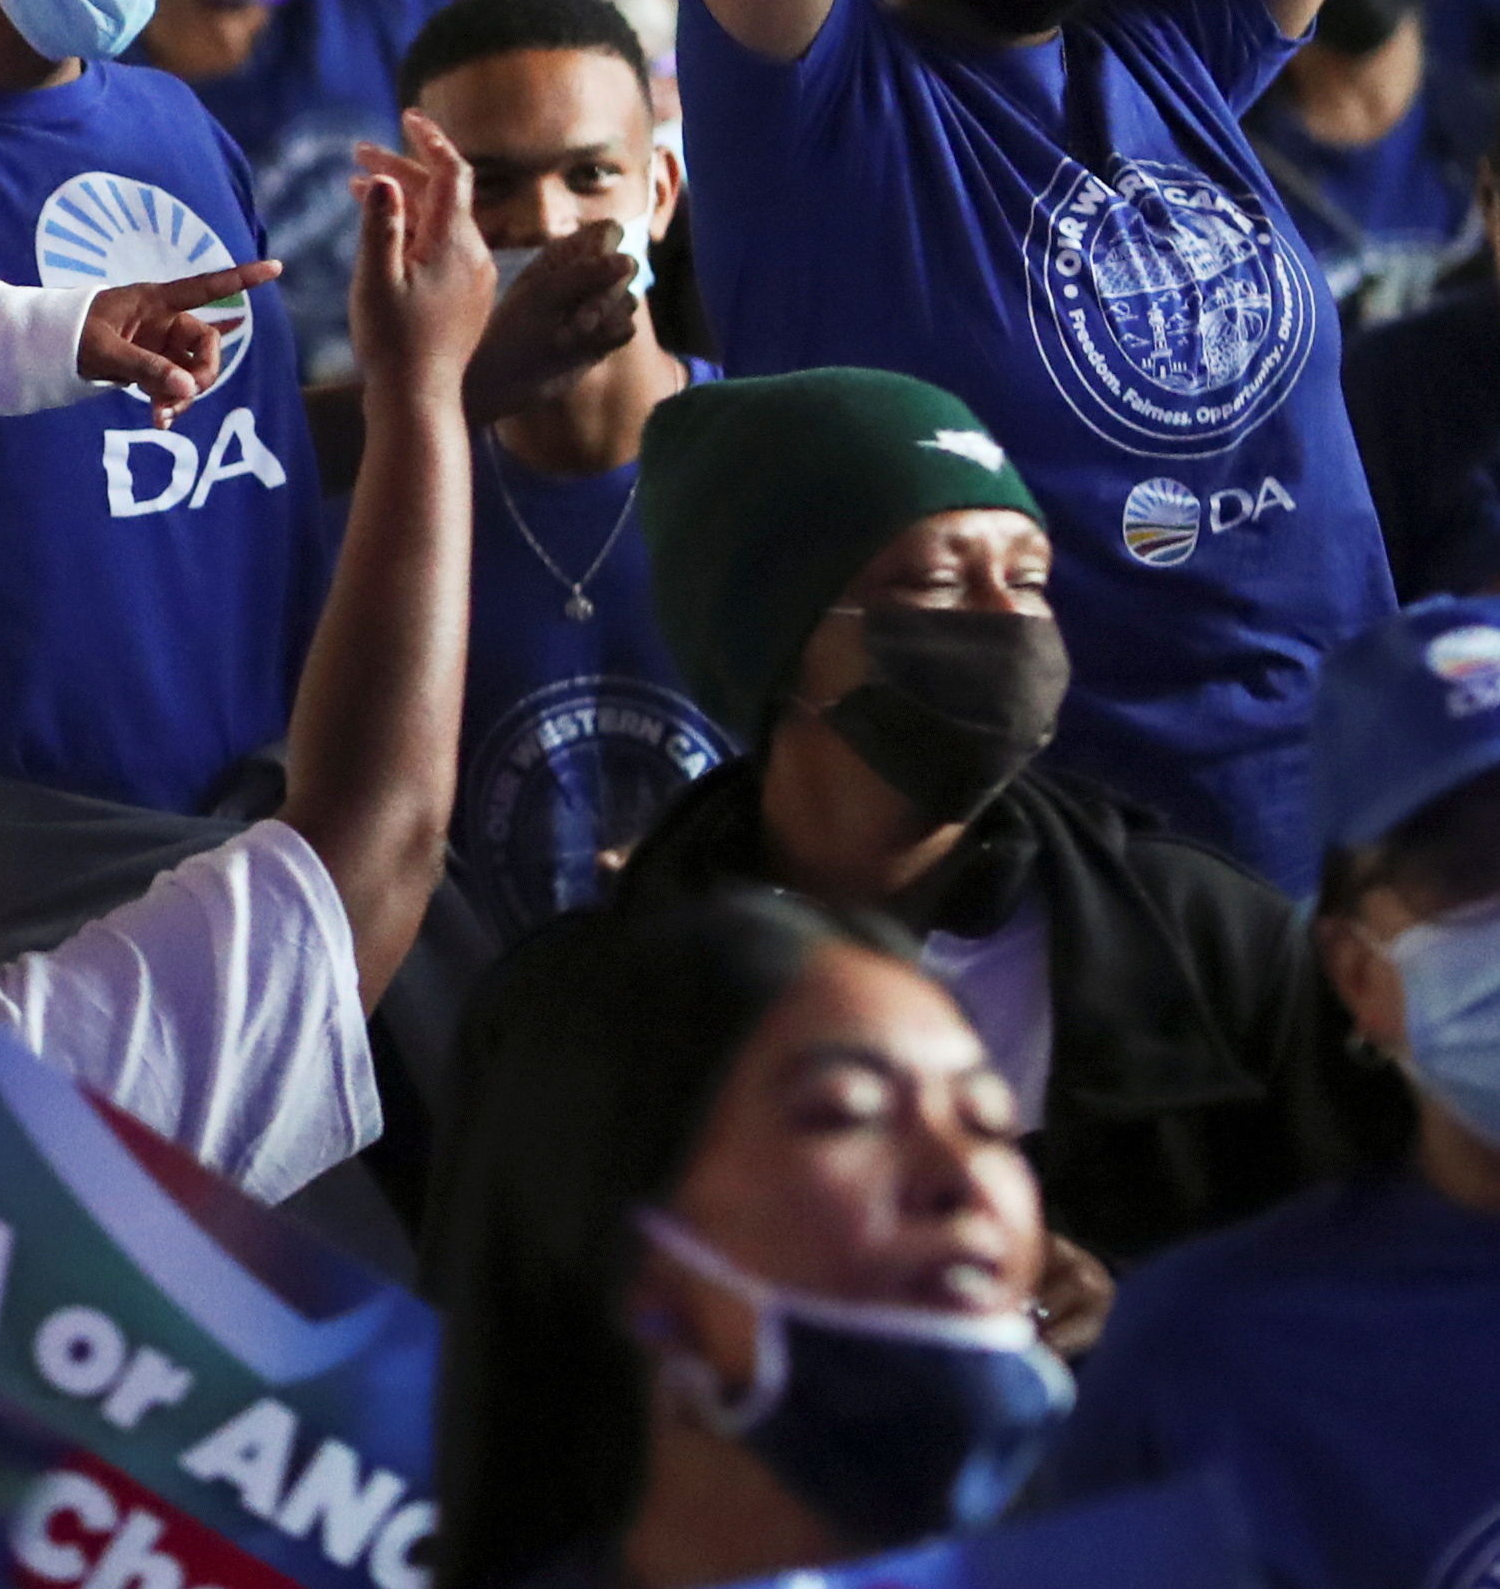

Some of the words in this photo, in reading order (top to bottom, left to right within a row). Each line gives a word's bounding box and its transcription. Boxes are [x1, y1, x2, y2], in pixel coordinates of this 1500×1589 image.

[102, 407, 287, 517] DA
[1209, 475, 1296, 534] DA
[33, 1306, 193, 1429] or
